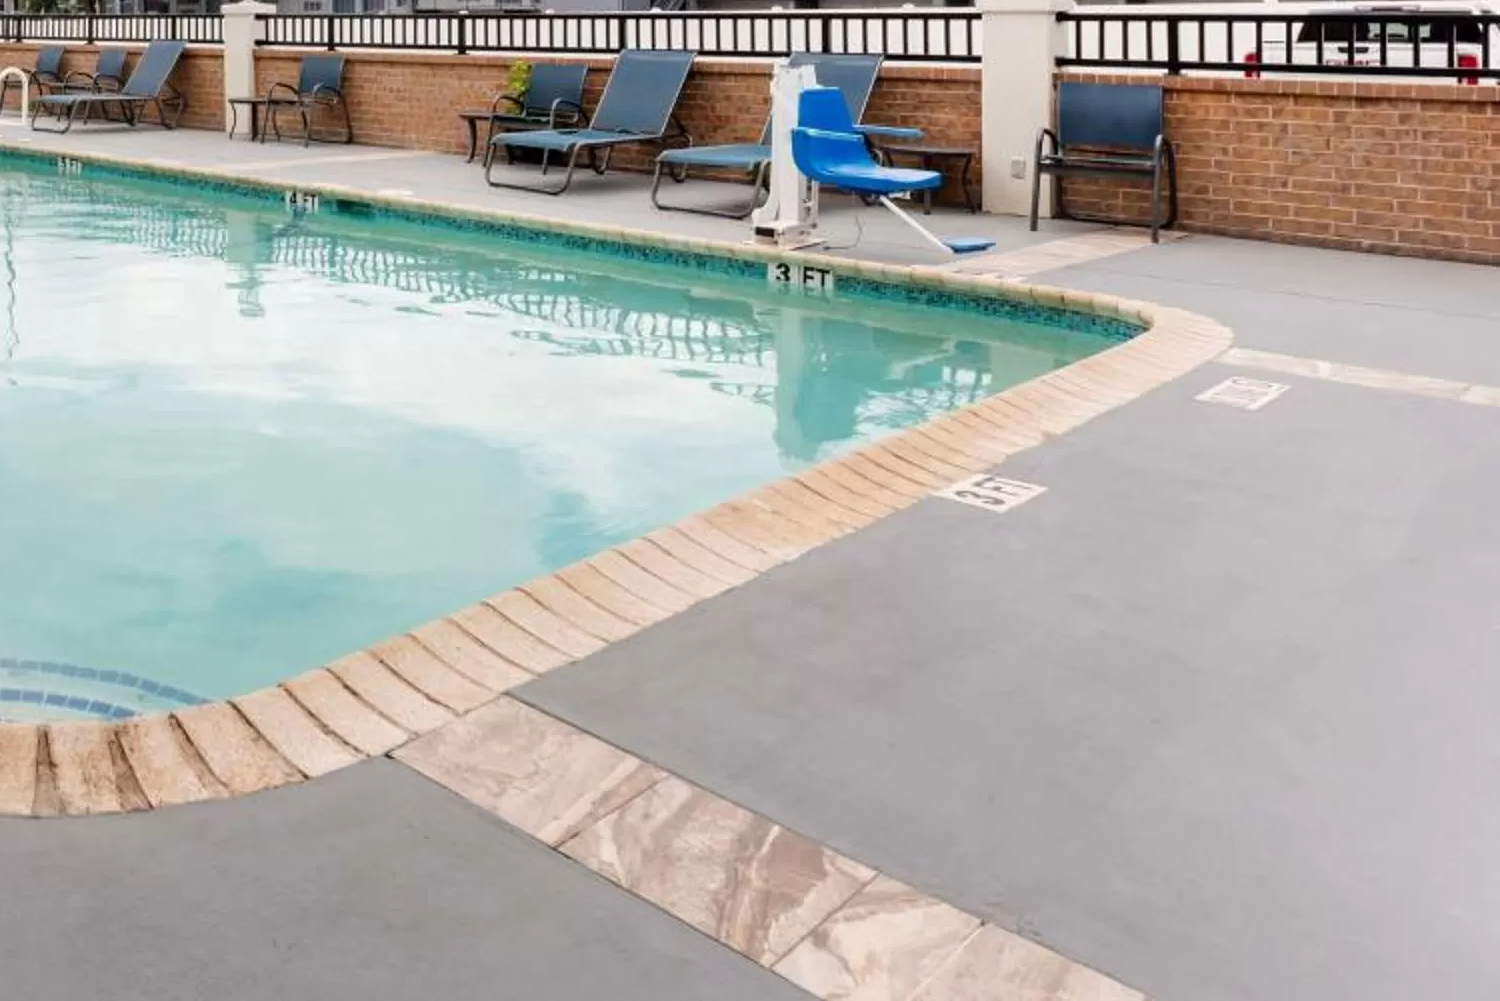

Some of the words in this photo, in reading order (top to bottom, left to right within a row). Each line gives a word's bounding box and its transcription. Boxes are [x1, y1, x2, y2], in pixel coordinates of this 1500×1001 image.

[303, 192, 316, 208] FT
[775, 263, 790, 281] 3
[804, 265, 830, 287] FT
[973, 477, 1033, 496] FT
[954, 490, 1005, 505] 3
